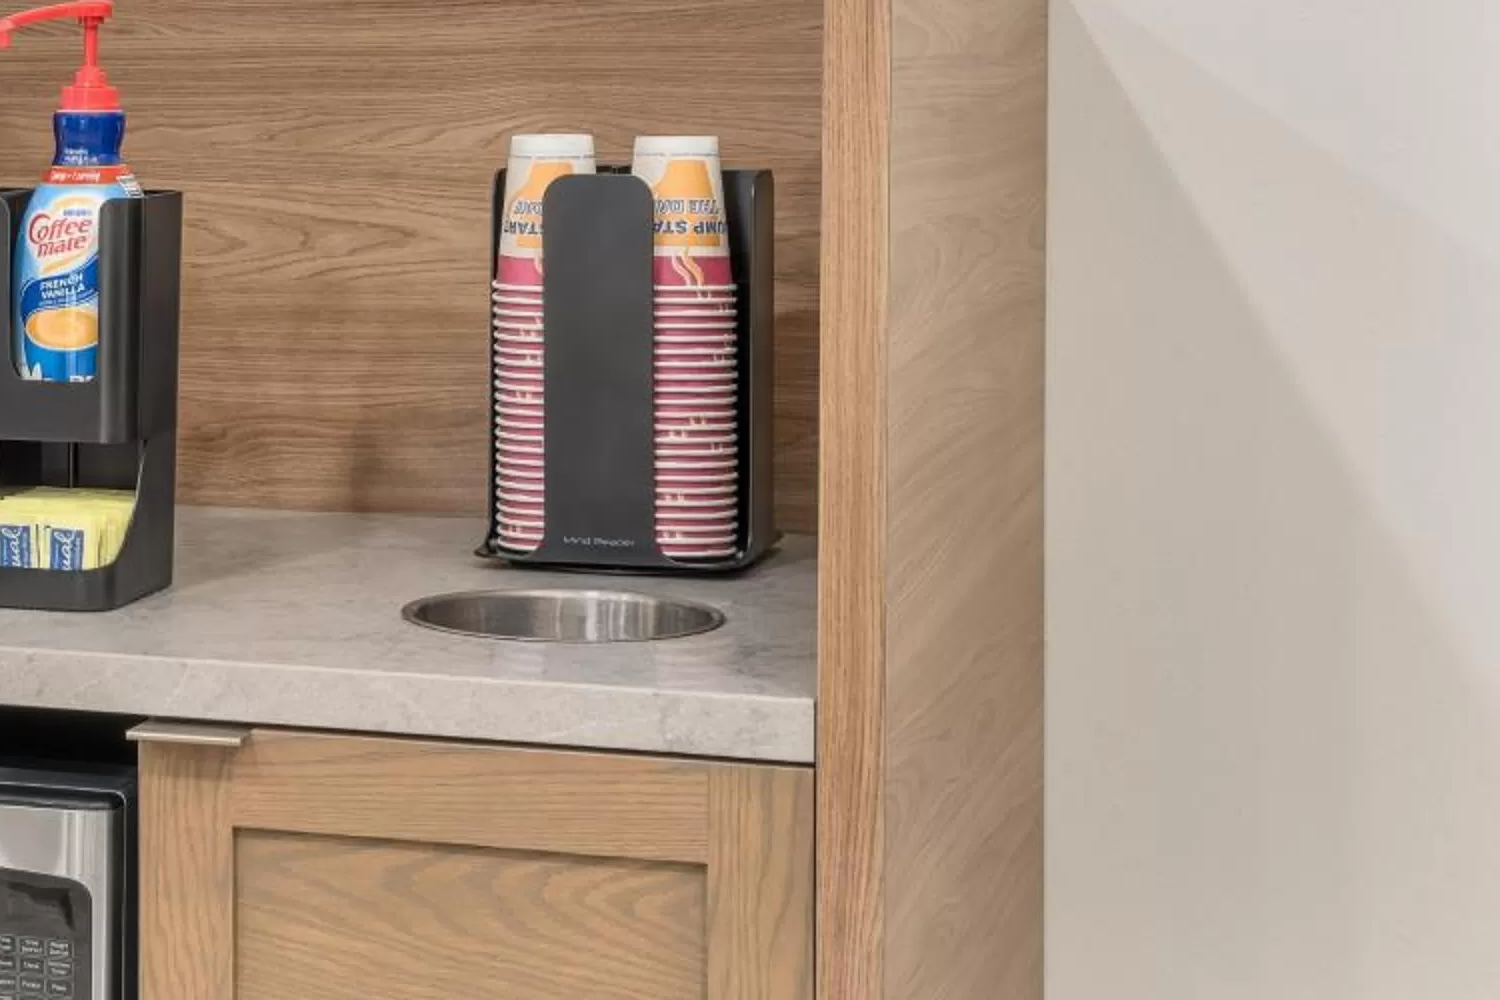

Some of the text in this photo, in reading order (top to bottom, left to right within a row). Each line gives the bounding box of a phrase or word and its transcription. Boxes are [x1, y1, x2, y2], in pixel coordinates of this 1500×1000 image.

[28, 212, 94, 245] Coffee
[36, 235, 87, 258] mate
[39, 271, 84, 291] FRENCH
[40, 283, 86, 300] VANILLA
